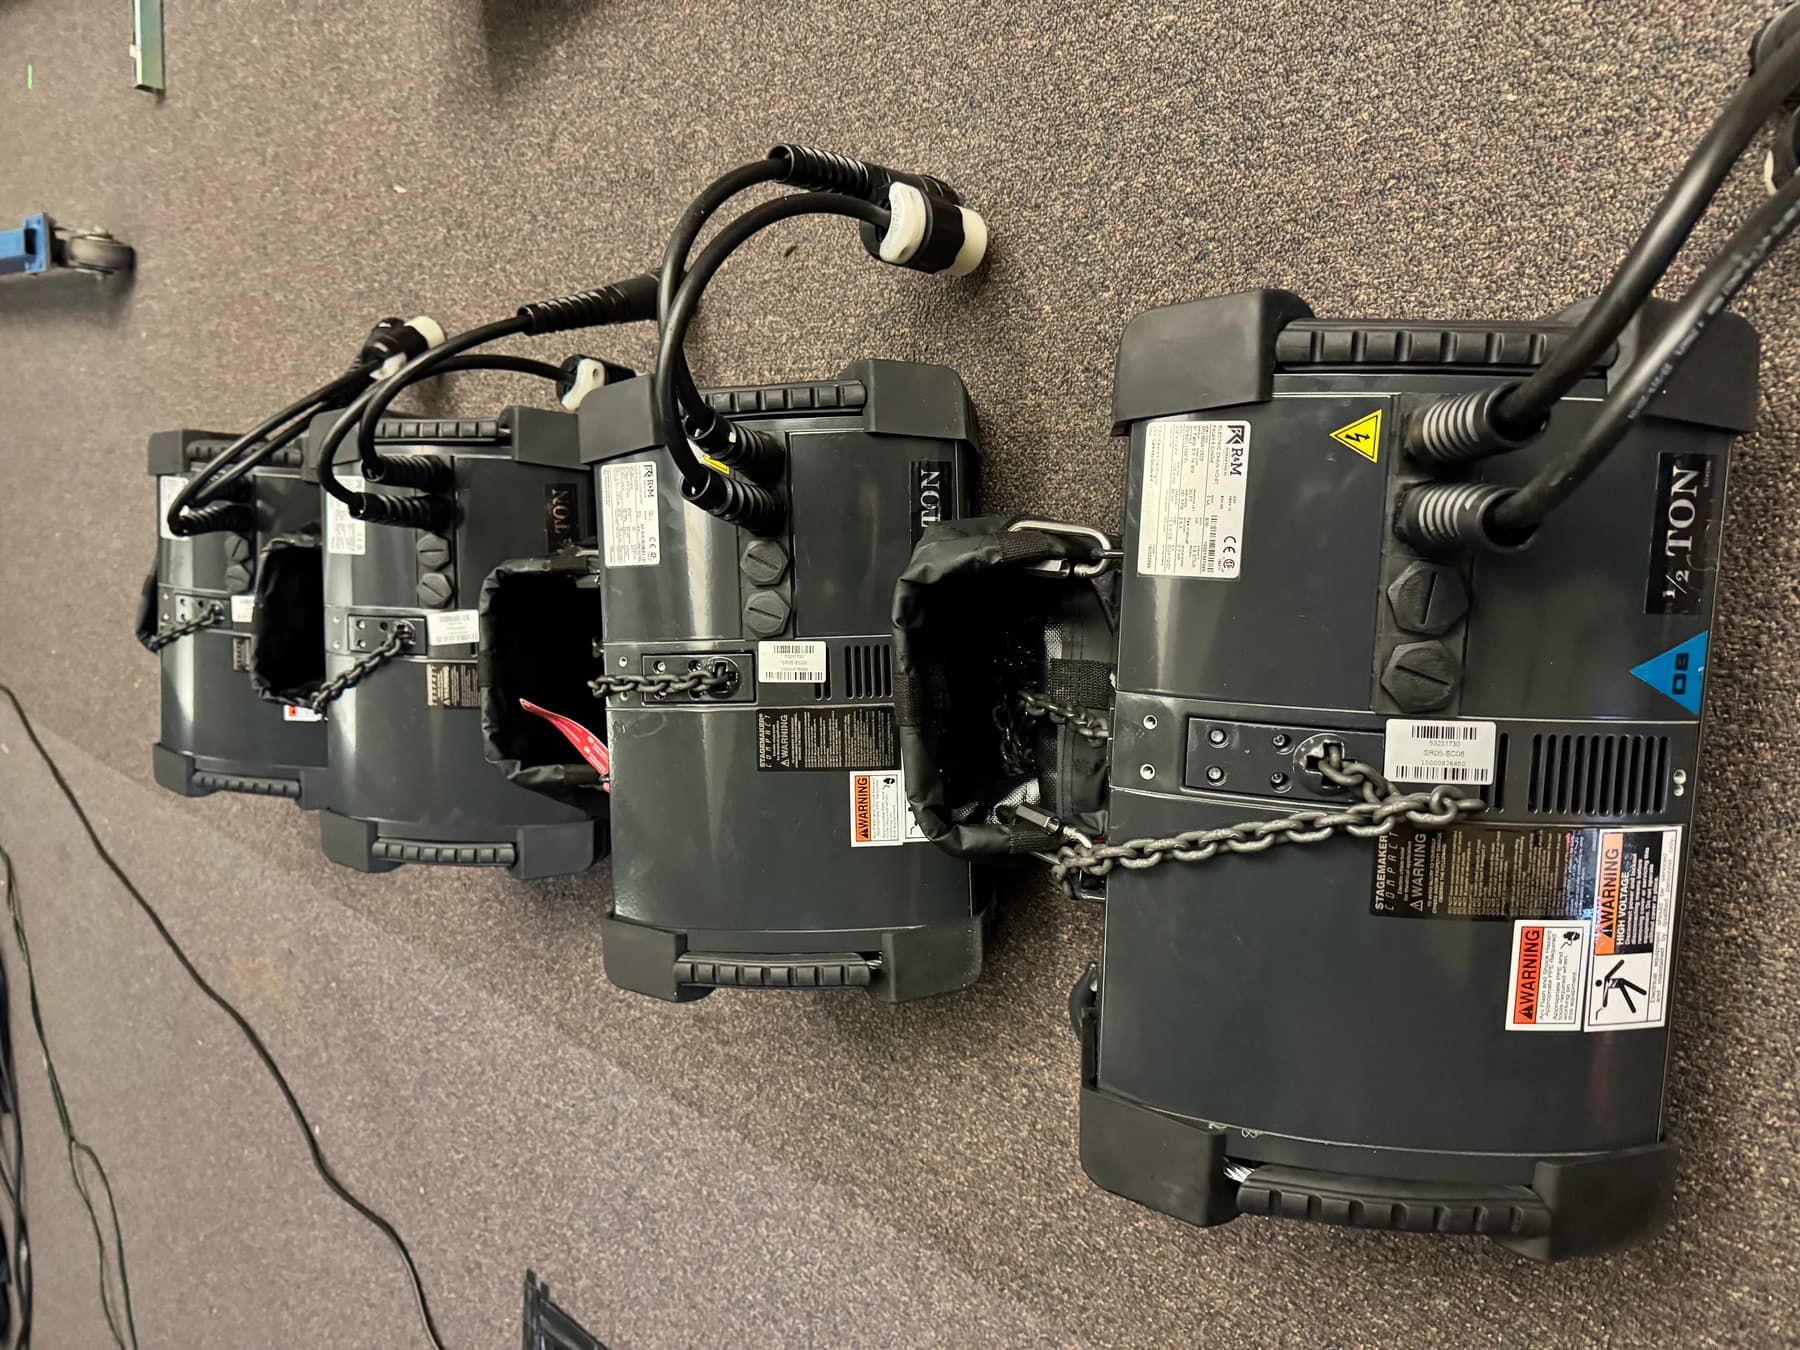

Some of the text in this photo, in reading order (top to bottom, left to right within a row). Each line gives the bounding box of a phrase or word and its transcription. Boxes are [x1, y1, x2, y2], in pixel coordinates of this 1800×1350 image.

[1230, 447, 1244, 476] R&M
[920, 468, 941, 528] TON
[1665, 464, 1699, 557] TON
[780, 714, 789, 758] WARNING
[857, 778, 868, 829] WARNING
[1375, 835, 1388, 910] STAGEMAKER
[1411, 833, 1427, 898] WARNING
[1601, 848, 1619, 924] WARNING
[1617, 872, 1630, 946] HIGH VOLTAGE
[1520, 930, 1540, 1006] WARNING
[1545, 980, 1553, 1016] Appropriate
[1549, 934, 1557, 963] Required
[1554, 982, 1562, 1020] Appropriate
